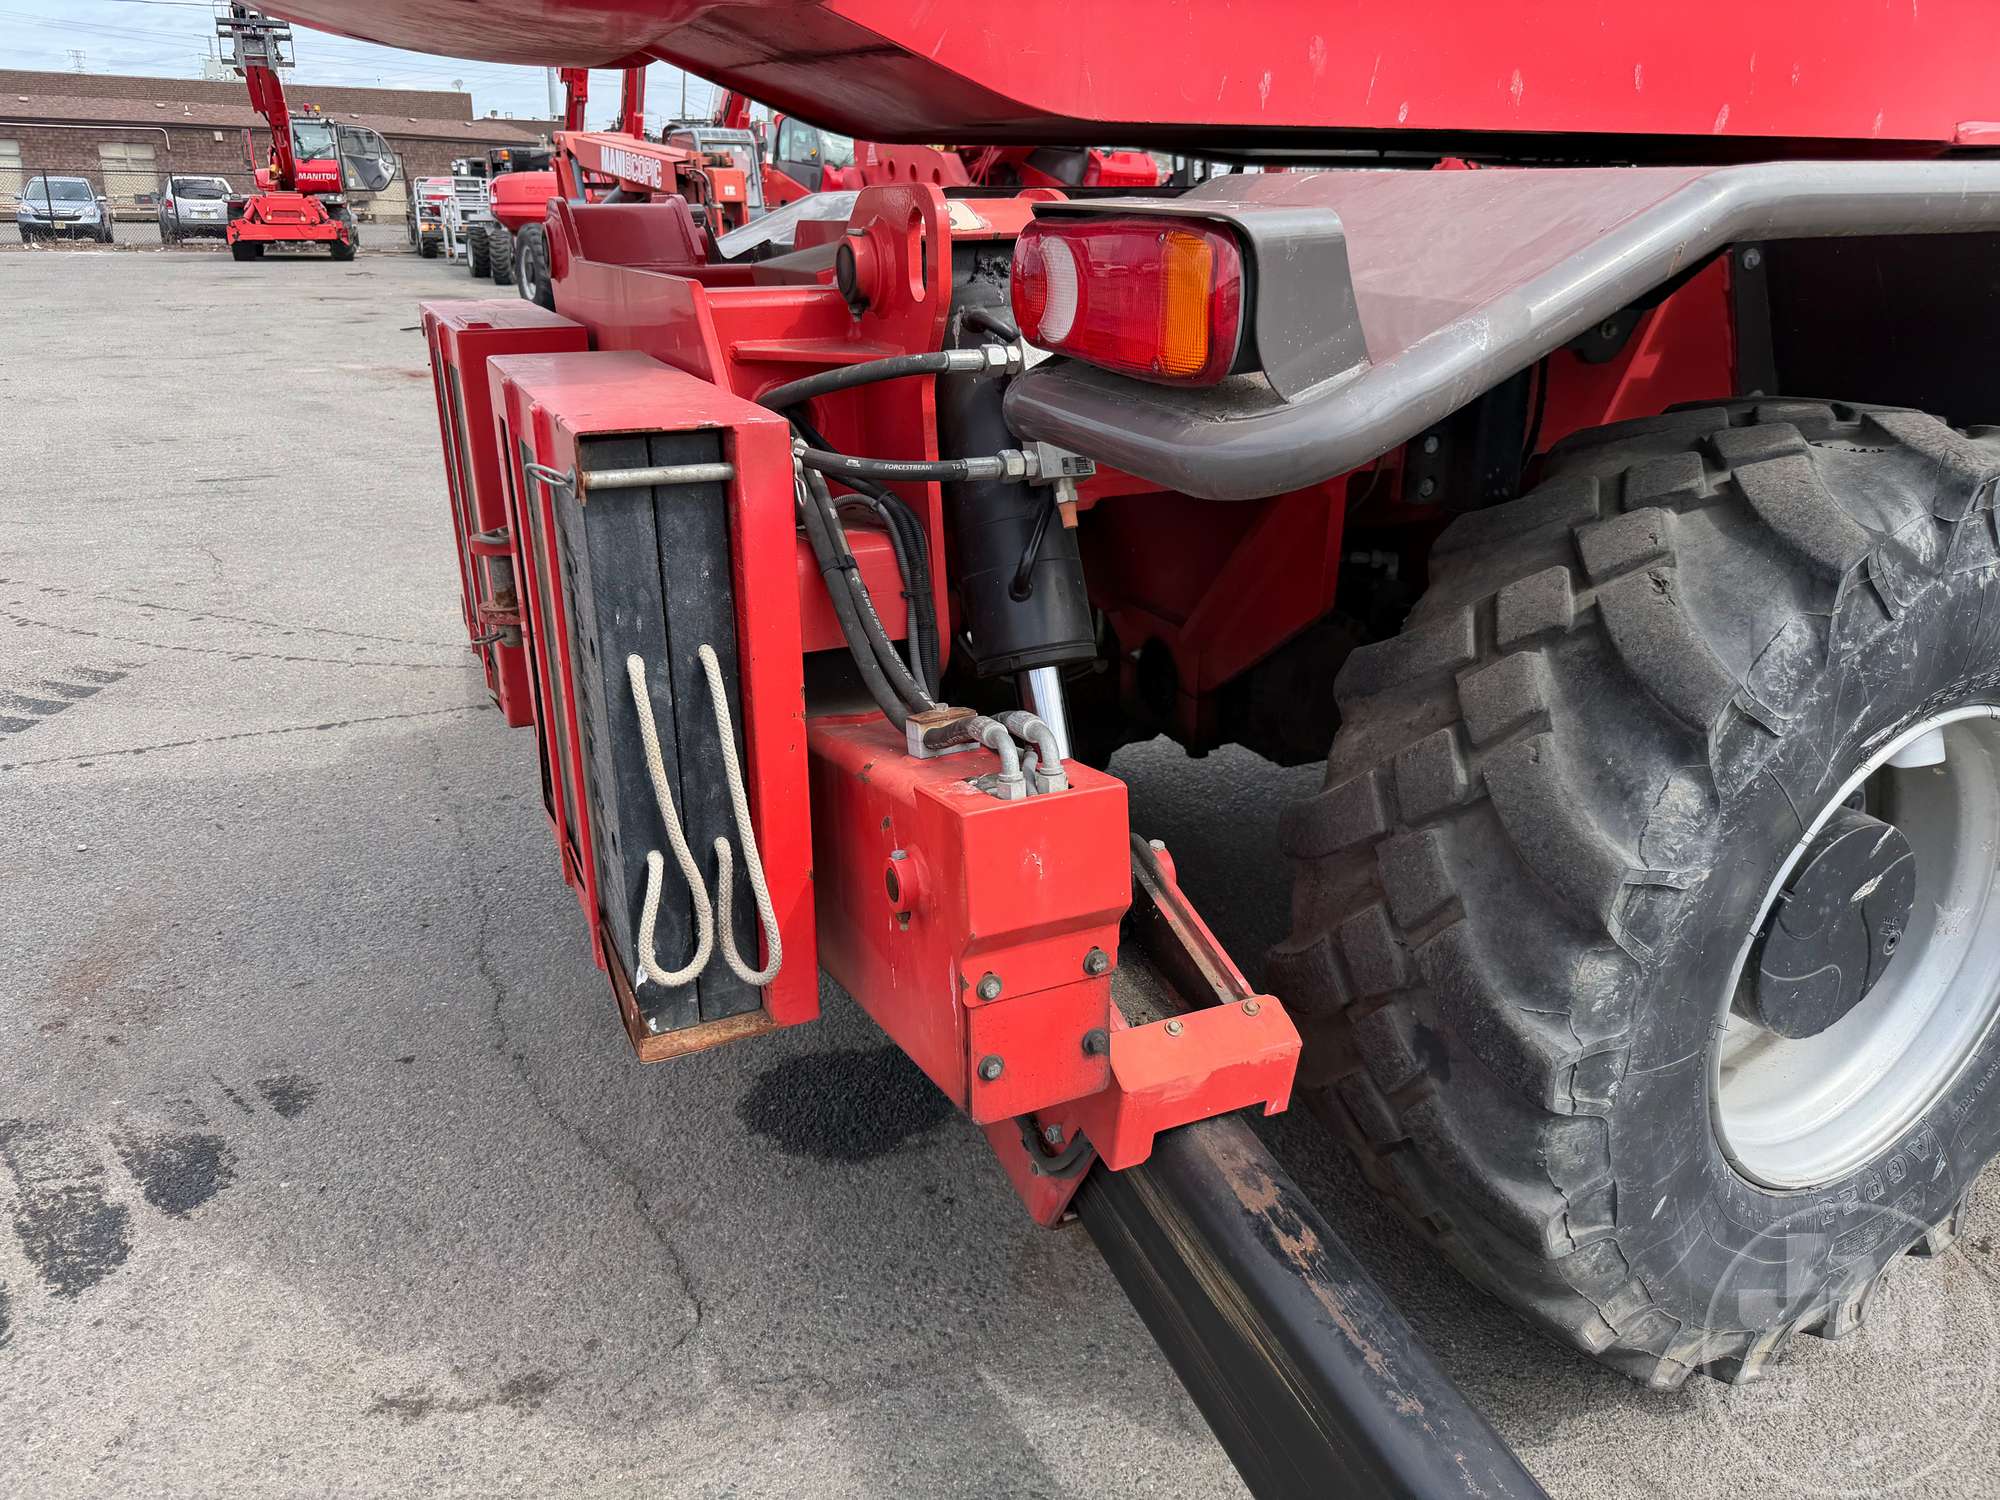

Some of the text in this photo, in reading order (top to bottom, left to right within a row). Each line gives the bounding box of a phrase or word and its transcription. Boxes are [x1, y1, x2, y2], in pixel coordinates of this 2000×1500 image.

[600, 146, 662, 189] MANISCOPIC
[298, 172, 337, 180] MANITOU
[884, 463, 933, 471] FORCESTREAM
